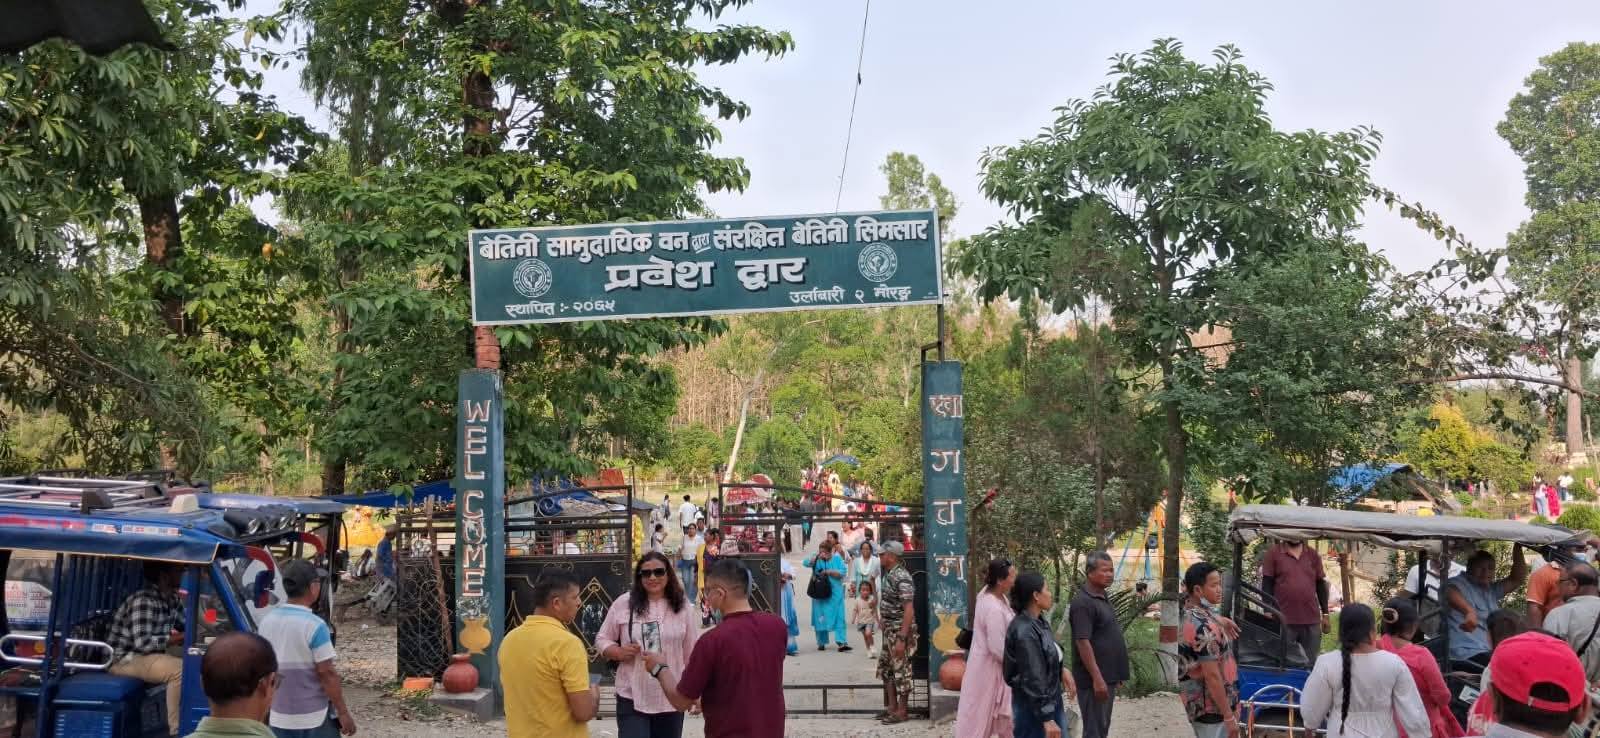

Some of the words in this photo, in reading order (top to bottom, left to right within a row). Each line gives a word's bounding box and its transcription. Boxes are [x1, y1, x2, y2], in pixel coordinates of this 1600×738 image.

[479, 233, 541, 260] बेतिनी
[546, 228, 654, 264] सामुदायिक
[658, 231, 690, 252] वन
[713, 221, 786, 251] संरक्षित
[791, 217, 849, 246] बेतिनी
[854, 215, 929, 242] सिमसार
[604, 255, 716, 292] प्रवेश
[734, 257, 808, 292] द्वार
[504, 300, 555, 319] स्थापित
[855, 289, 865, 304] २
